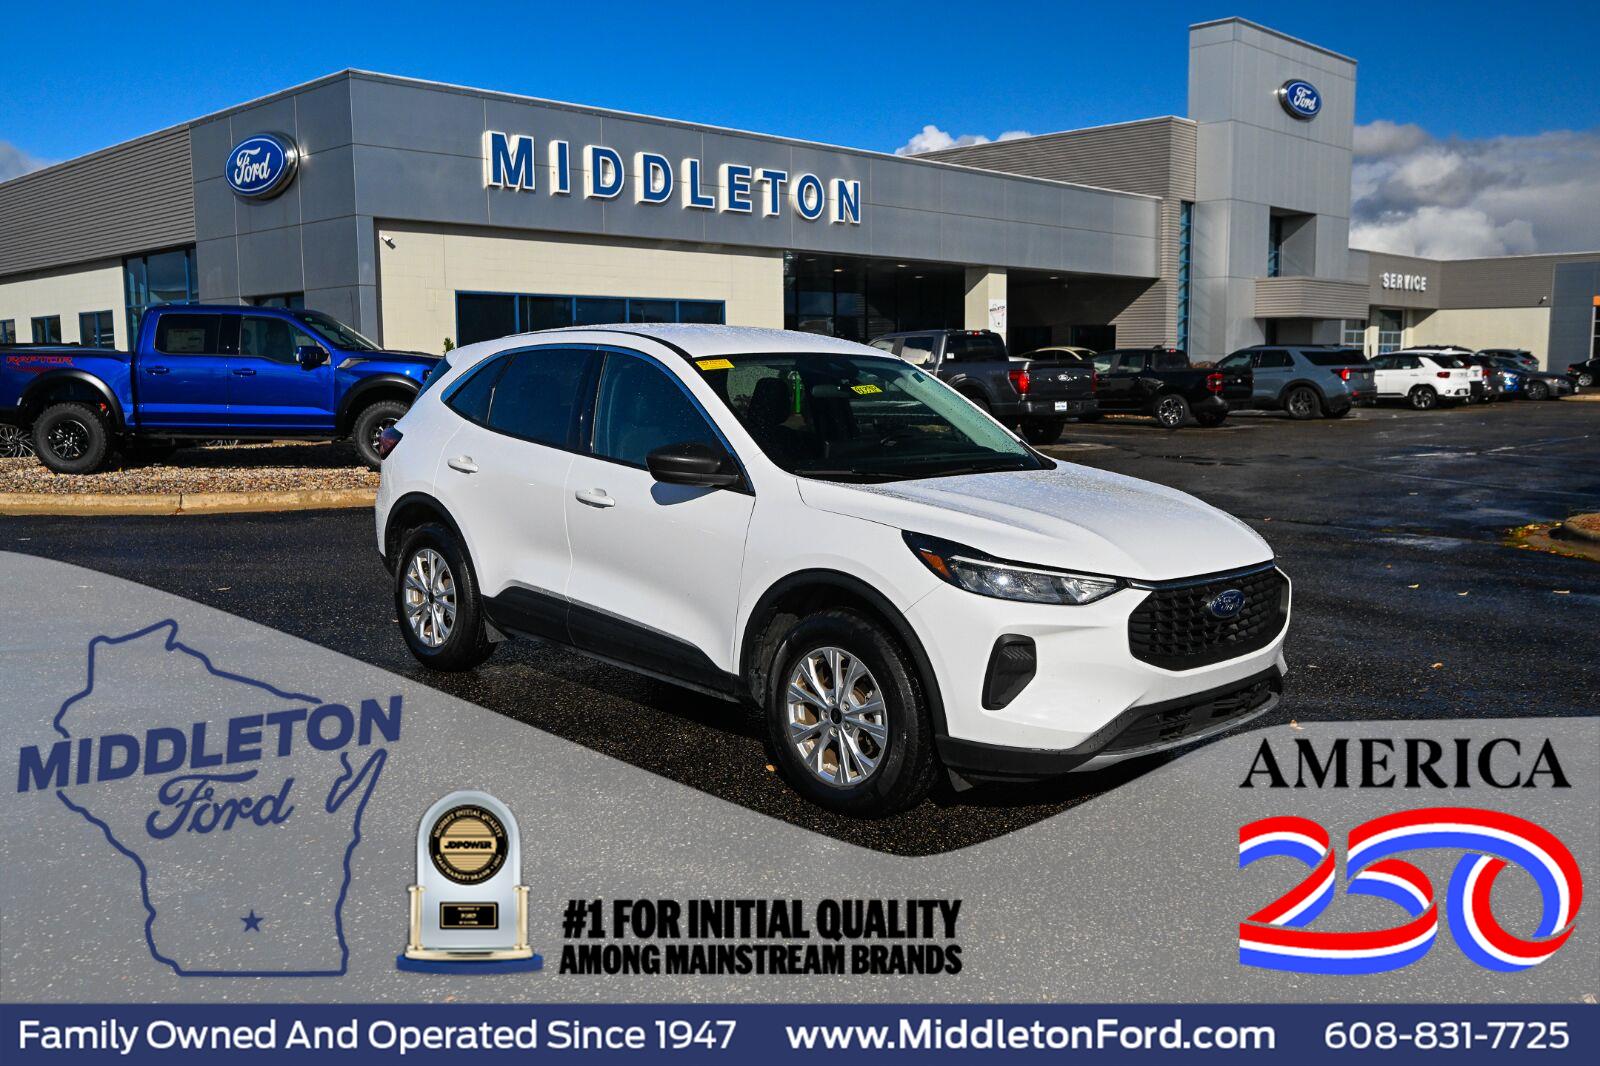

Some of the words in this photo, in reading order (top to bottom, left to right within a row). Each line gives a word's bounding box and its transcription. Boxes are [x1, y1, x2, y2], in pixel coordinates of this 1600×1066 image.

[1293, 86, 1317, 111] Ford
[234, 146, 271, 186] Ford
[482, 130, 862, 225] MIDDLETON
[1382, 272, 1427, 292] SERVICE
[6, 355, 74, 367] RAPTOR
